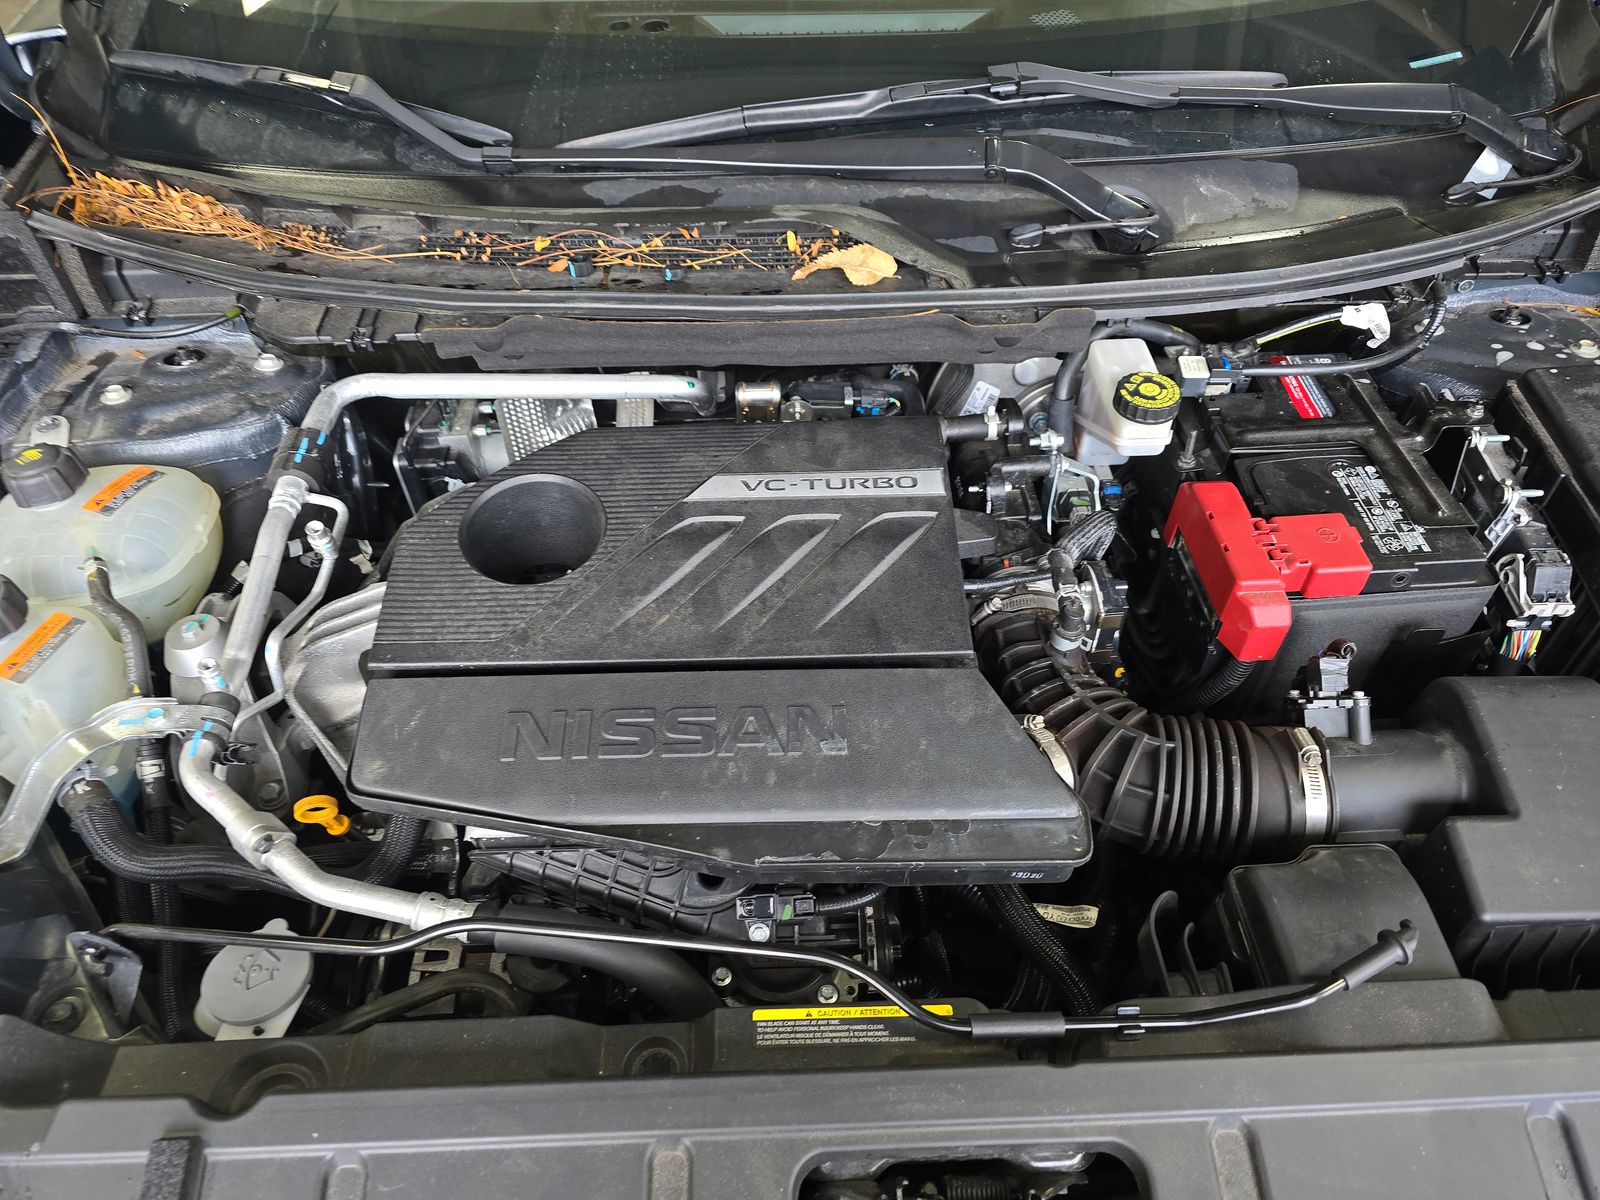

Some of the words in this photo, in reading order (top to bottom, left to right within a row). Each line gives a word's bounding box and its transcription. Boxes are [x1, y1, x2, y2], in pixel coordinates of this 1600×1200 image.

[740, 476, 918, 492] VC-TURBO
[500, 704, 848, 762] NISSAN
[817, 1009, 851, 1017] CAUTION
[860, 1008, 901, 1016] ATTENTION
